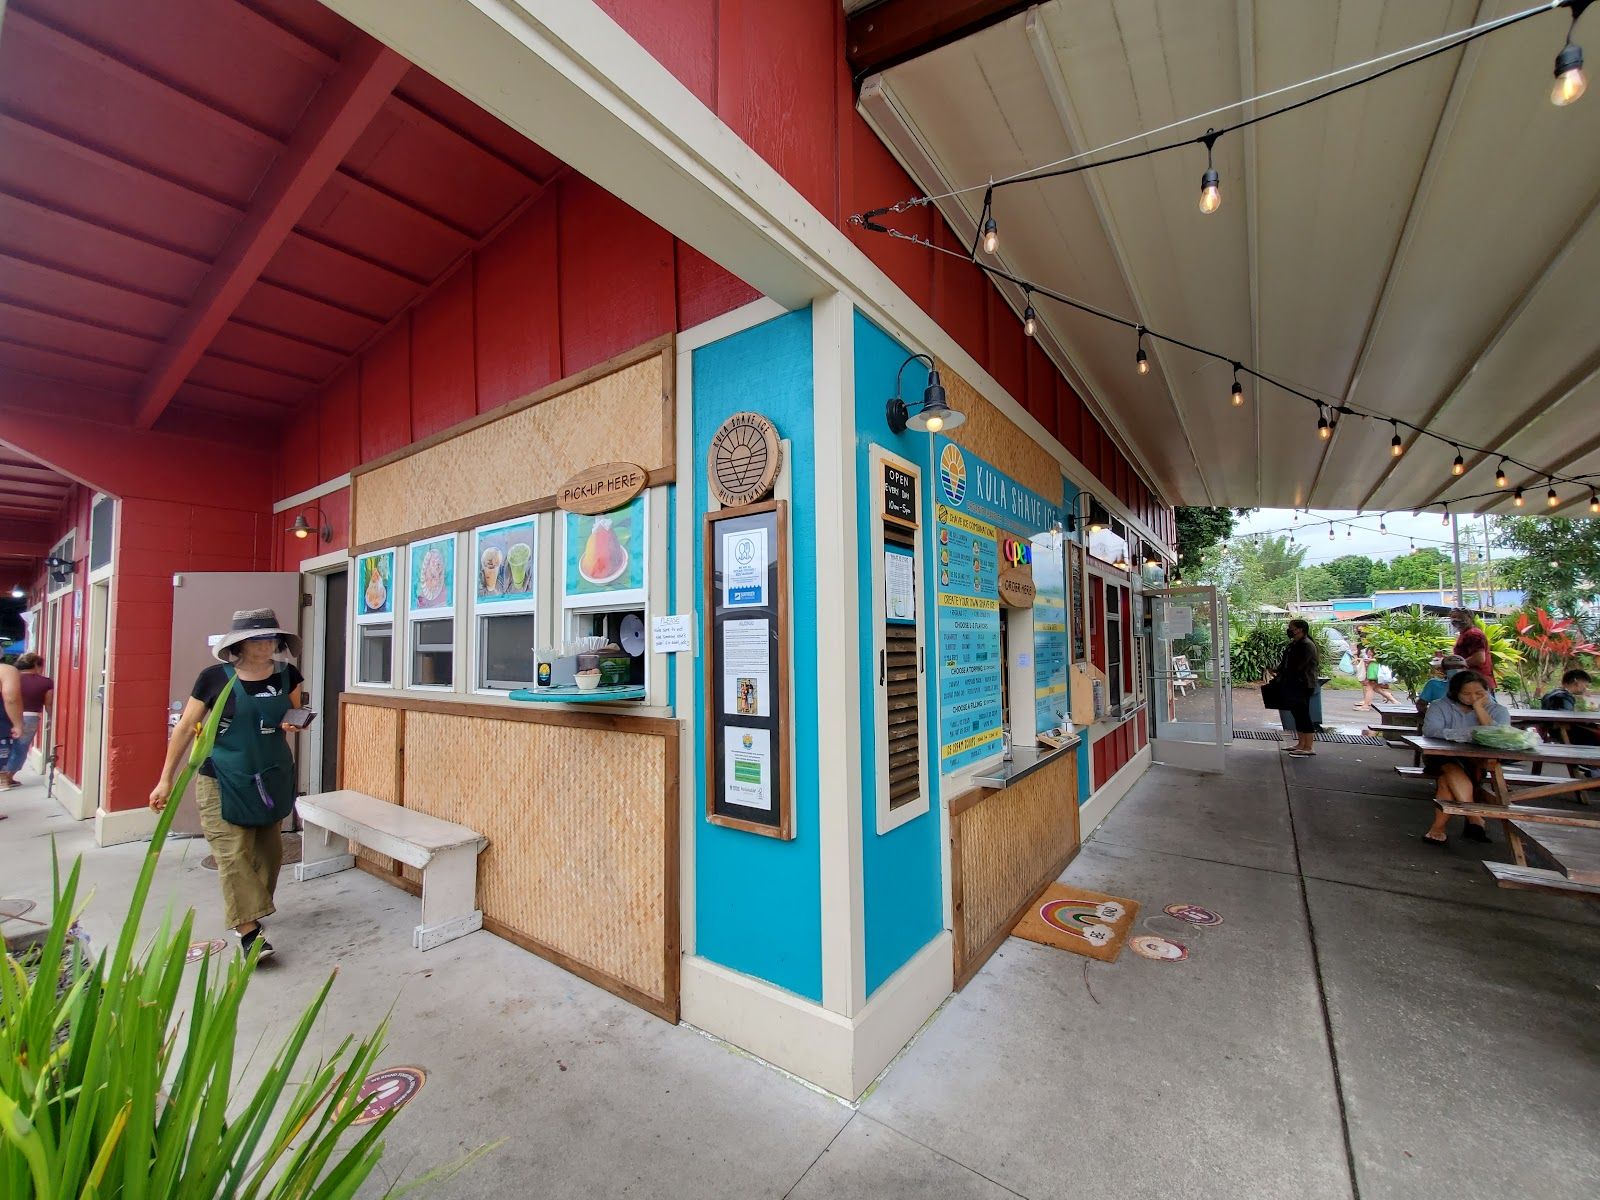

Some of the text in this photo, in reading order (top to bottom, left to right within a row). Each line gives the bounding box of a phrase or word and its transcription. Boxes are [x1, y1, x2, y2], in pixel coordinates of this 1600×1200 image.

[713, 415, 770, 448] KULA SHAVE ICE
[889, 470, 909, 487] OPEN
[564, 472, 636, 503] PICK-UP HERE
[719, 481, 767, 505] HILO HAWAII
[885, 482, 910, 500] EVERY DAY
[976, 465, 1007, 510] KULA
[1011, 486, 1041, 527] SHAVE
[1005, 579, 1021, 593] ORDER
[1021, 584, 1032, 596] HERE
[943, 594, 959, 606] CREATE
[959, 596, 970, 607] YOUR
[954, 621, 969, 629] CHOOSE
[950, 666, 966, 675] CHOOSE
[952, 703, 968, 714] CHOOSE
